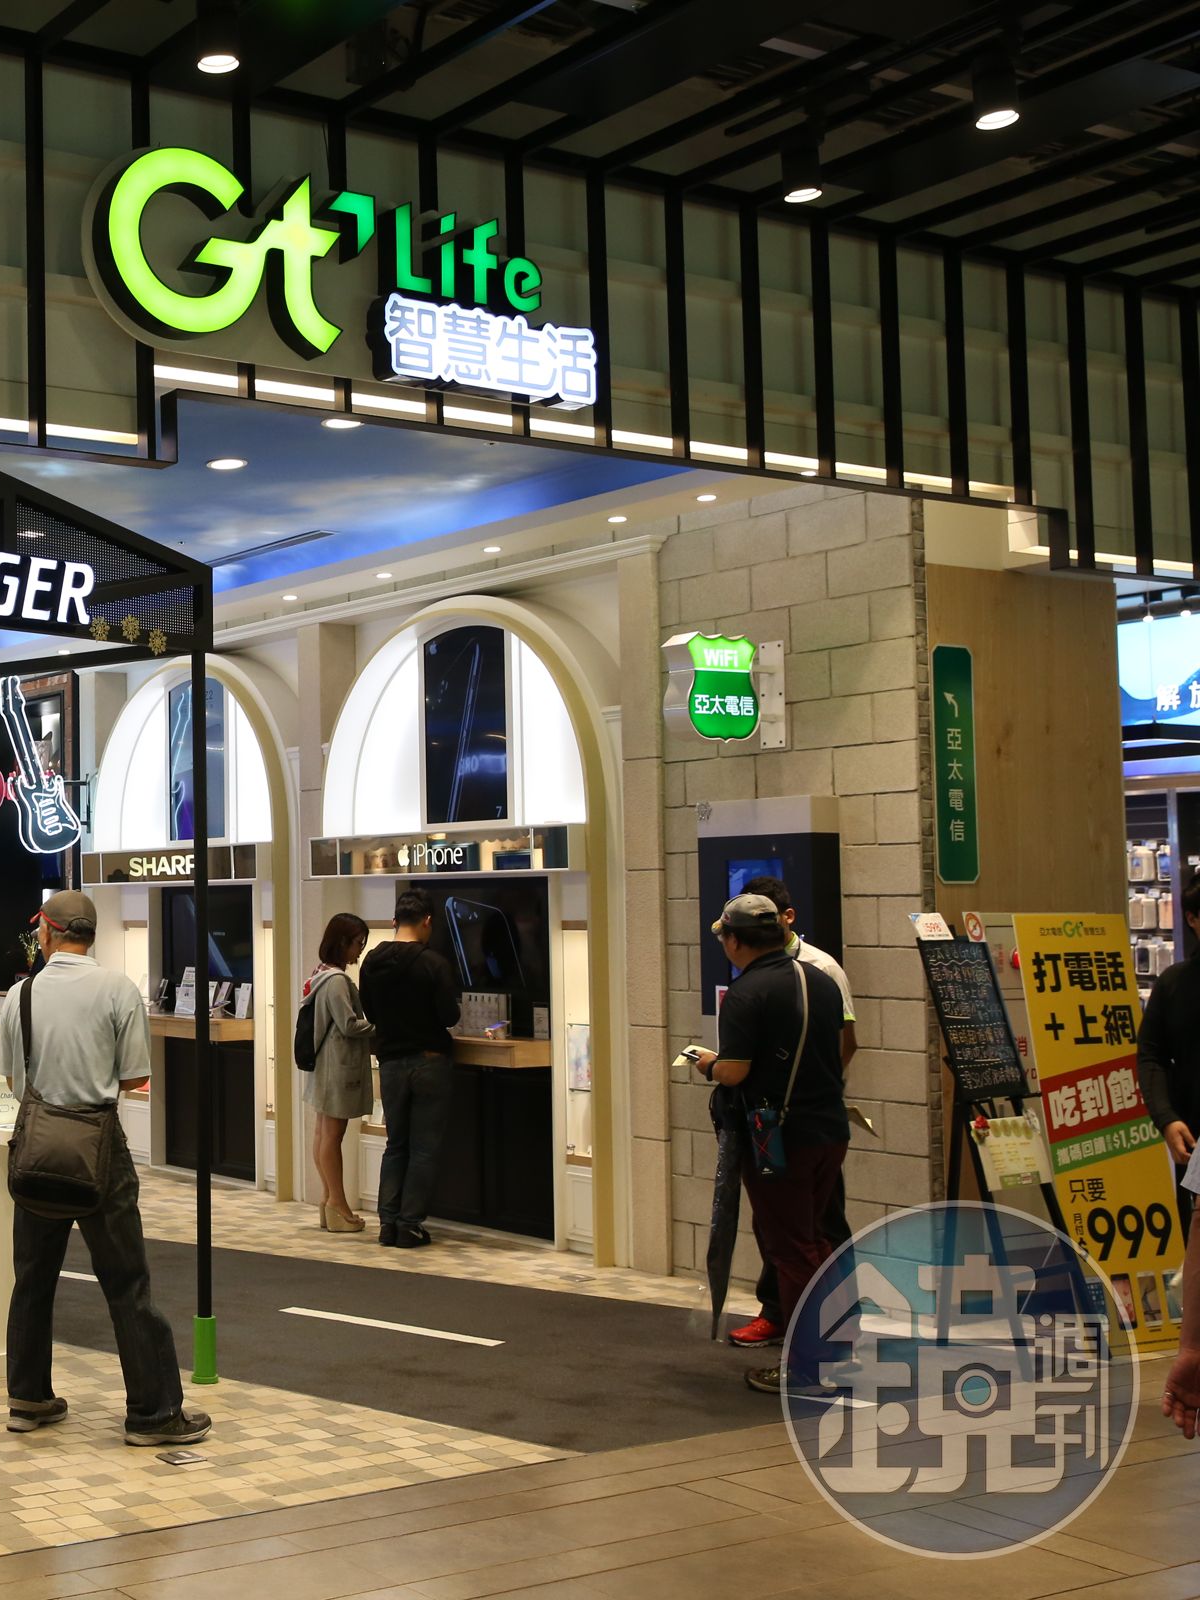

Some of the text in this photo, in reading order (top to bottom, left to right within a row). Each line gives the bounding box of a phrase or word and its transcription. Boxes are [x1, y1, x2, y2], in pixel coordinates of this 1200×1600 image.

[109, 147, 344, 354] Gt
[396, 202, 542, 313] Life
[387, 297, 596, 403] 智慧生活
[703, 649, 738, 668] WiFi
[694, 694, 755, 717] 亞太電信
[946, 728, 965, 842] 亞太電信
[413, 842, 464, 868] iPhone
[1032, 951, 1128, 993] 打電話
[1048, 1067, 1145, 1130] 吃到飽
[1069, 1177, 1107, 1203] 只要
[1087, 1203, 1173, 1262] 999
